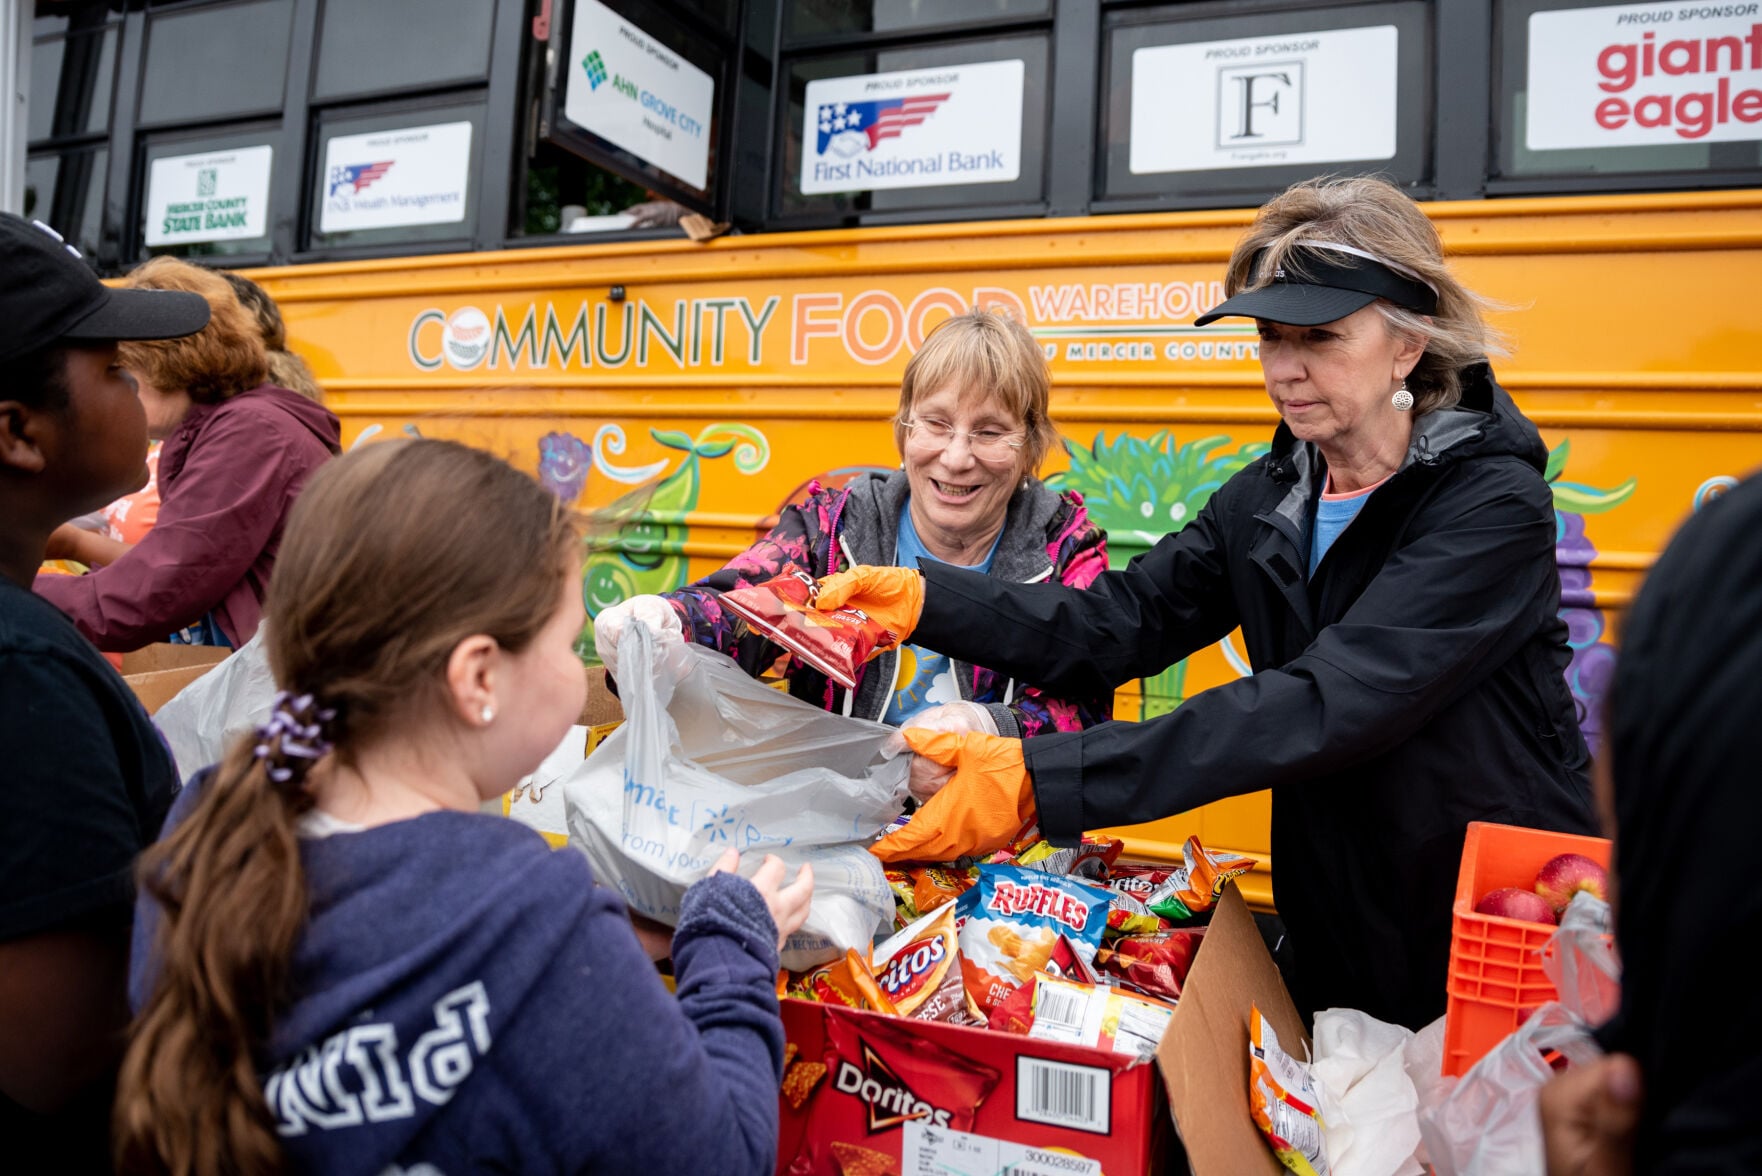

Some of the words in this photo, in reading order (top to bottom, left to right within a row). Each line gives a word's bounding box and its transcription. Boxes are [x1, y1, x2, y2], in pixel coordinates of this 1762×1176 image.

[1617, 12, 1674, 25] PROUD
[1678, 4, 1759, 21] SPONSOR
[619, 26, 645, 49] PROUD
[646, 45, 680, 72] SPONSOR
[1205, 48, 1251, 60] PROUD
[1256, 39, 1320, 54] SPONSOR
[1597, 23, 1762, 93] giant
[865, 80, 902, 92] PROUD
[907, 73, 960, 88] SPONSOR
[612, 73, 639, 101] AHN
[640, 89, 677, 126] GROVE
[678, 112, 703, 139] CITY
[1229, 72, 1292, 139] F
[1595, 77, 1762, 139] eagle
[814, 160, 852, 181] First
[856, 154, 943, 179] National
[948, 150, 1004, 171] Bank
[161, 215, 201, 235] STATE
[204, 211, 248, 230] BANK
[205, 197, 248, 211] COUNTY
[1029, 281, 1231, 321] WAREHOU
[408, 295, 782, 372] COMMUNITY
[1066, 342, 1156, 361] MERCER
[1164, 340, 1261, 361] COUNTY
[988, 881, 1089, 932] RUFFLES
[880, 935, 946, 995] ritos
[836, 1061, 952, 1130] Doritos
[1025, 1149, 1094, 1174] 300028597
